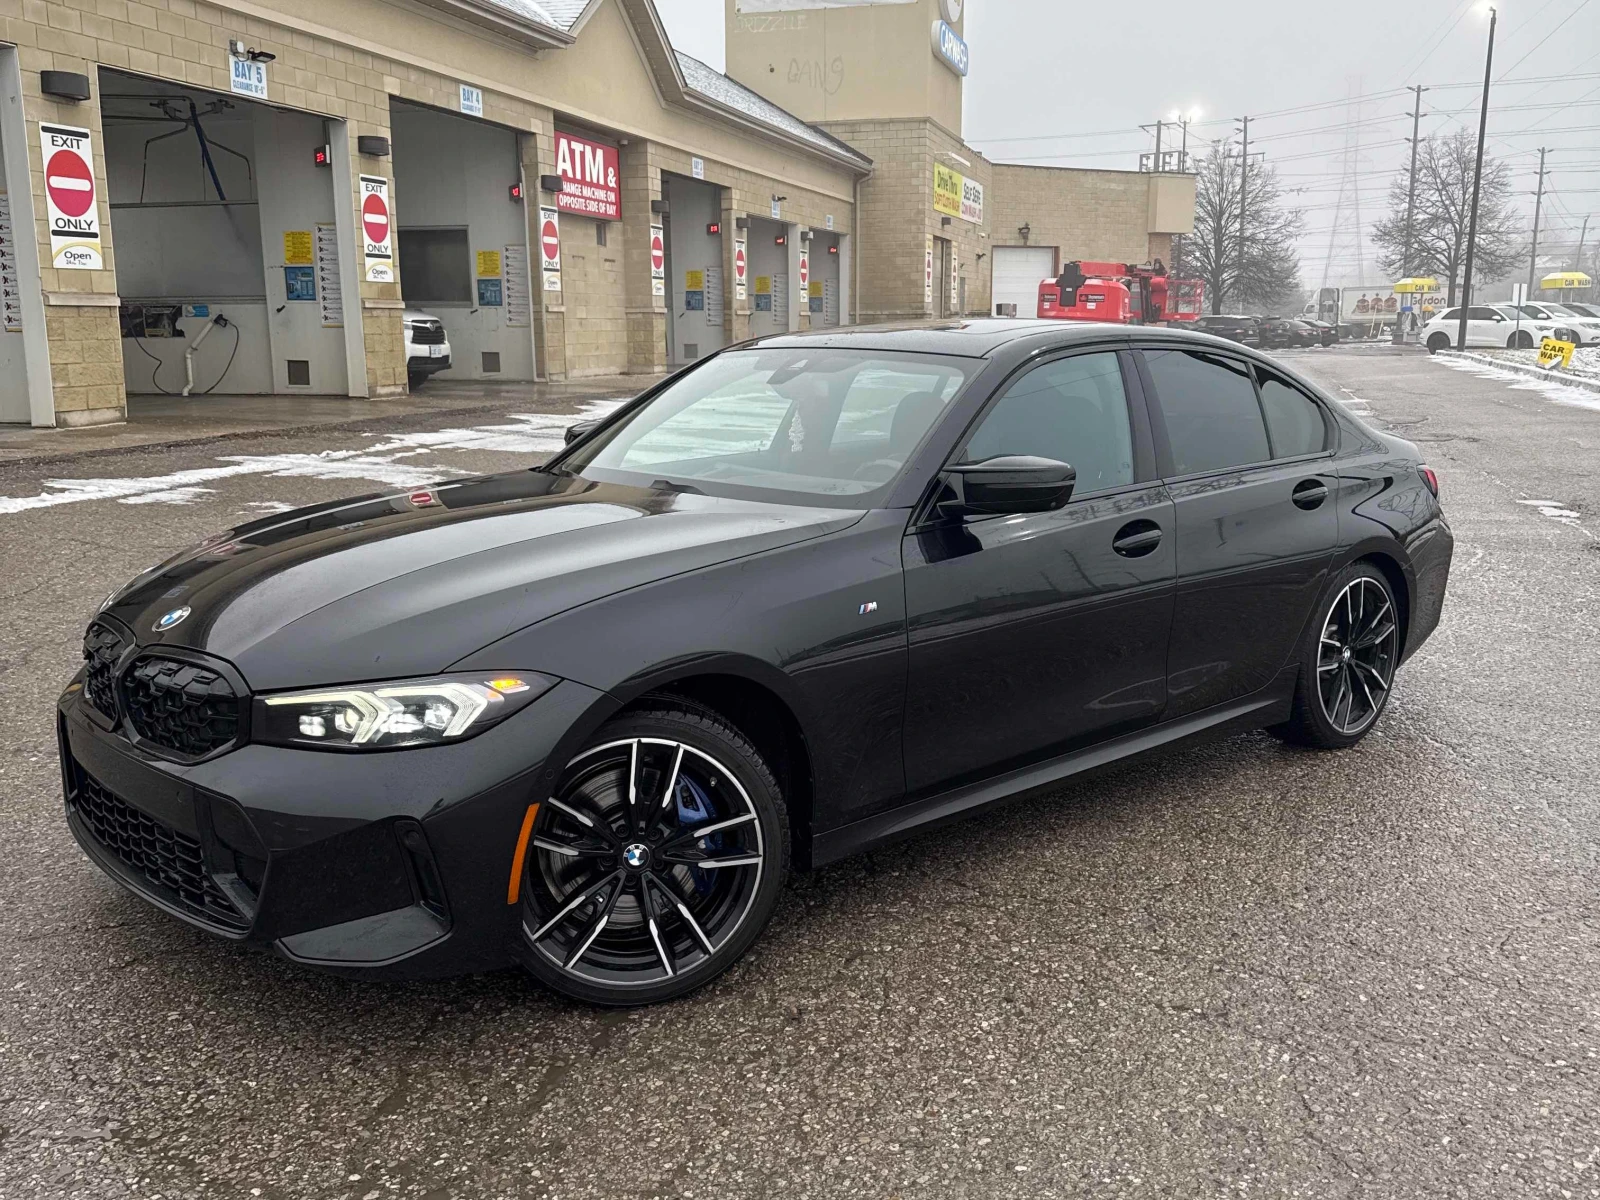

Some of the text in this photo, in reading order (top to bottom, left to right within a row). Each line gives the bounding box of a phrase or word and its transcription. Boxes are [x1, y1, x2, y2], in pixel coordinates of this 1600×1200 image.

[234, 60, 263, 84] BAY 5
[462, 87, 480, 106] BAY 4
[51, 135, 82, 150] EXIT
[556, 137, 617, 188] ATM &
[365, 183, 383, 193] EXIT
[563, 181, 616, 203] HANGE MACHINE ON
[559, 194, 617, 216] OPPOSITE SIDE OF BAY
[543, 212, 555, 220] EXIT
[55, 217, 94, 231] ONLY
[367, 243, 389, 254] ONLY
[64, 251, 92, 261] Open
[545, 260, 559, 268] ONLY
[371, 268, 388, 277] Open
[1414, 284, 1441, 292] CAR WASH
[1564, 279, 1575, 287] CAR
[1543, 344, 1565, 354] CAR
